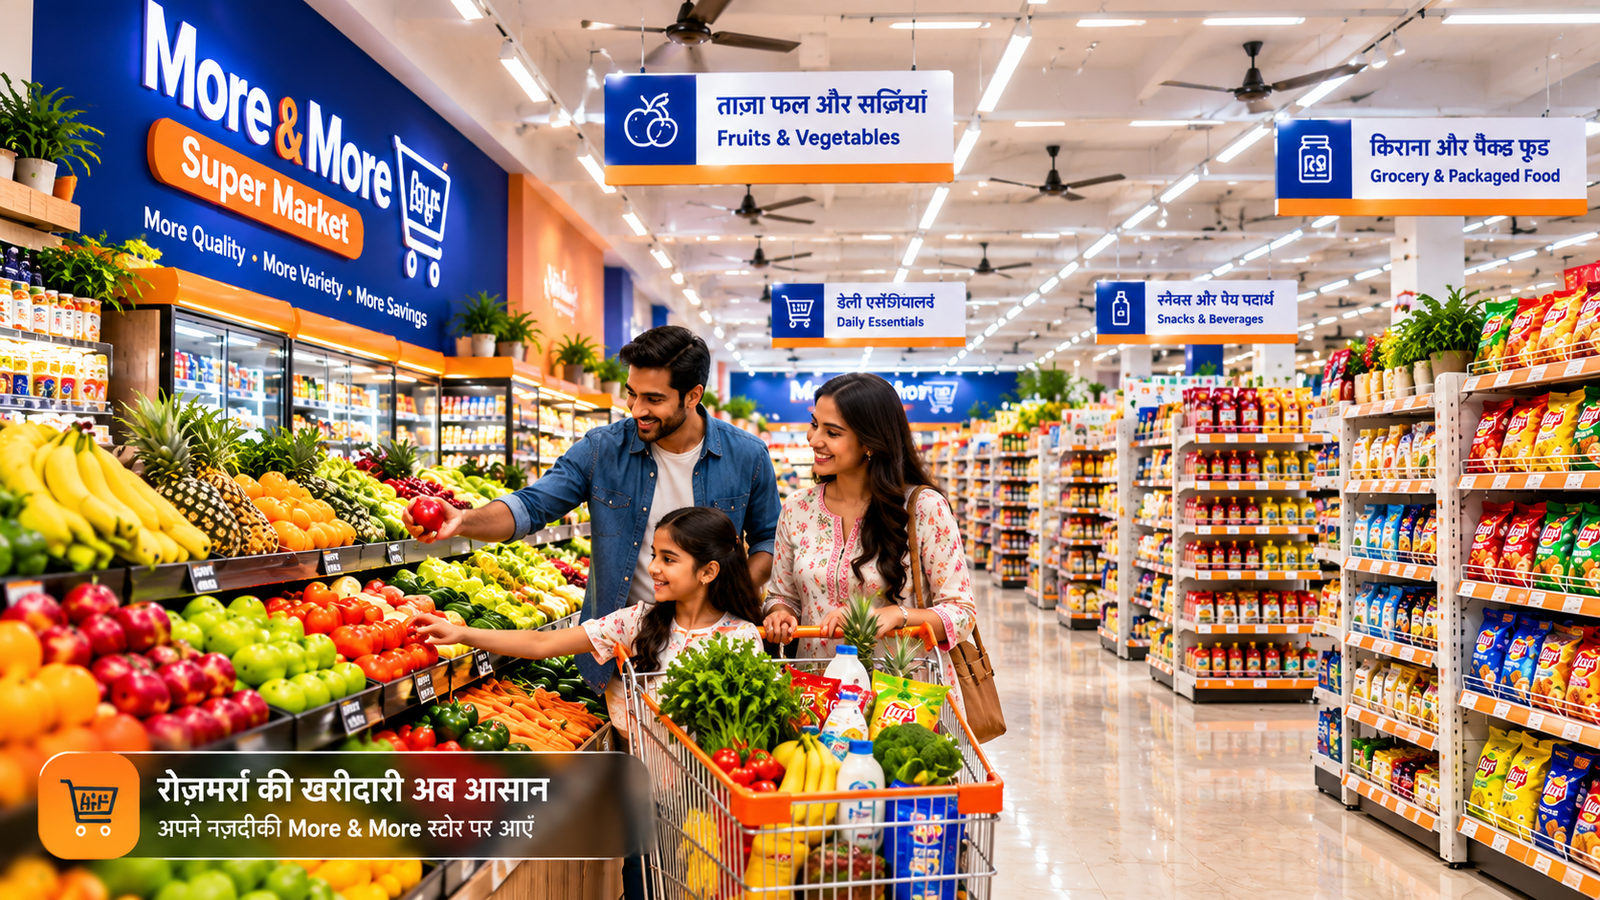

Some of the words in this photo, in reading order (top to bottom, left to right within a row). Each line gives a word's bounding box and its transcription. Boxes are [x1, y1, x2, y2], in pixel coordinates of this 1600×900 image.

[142, 0, 272, 146] More
[275, 97, 303, 165] &
[306, 99, 392, 209] More
[770, 96, 811, 115] फल
[816, 88, 852, 114] और
[717, 128, 771, 147] Fruits
[776, 129, 791, 147] &
[795, 128, 901, 151] Vegetables
[1369, 133, 1432, 157] किराना
[1436, 133, 1469, 157] और
[1518, 139, 1551, 164] फूड
[181, 135, 266, 207] Super
[273, 178, 349, 245] Market
[1370, 168, 1430, 187] Grocery
[1433, 168, 1445, 183] &
[1449, 168, 1520, 187] Packaged
[1524, 168, 1561, 183] Food
[144, 206, 188, 242] More
[192, 225, 245, 267] Quality
[263, 250, 297, 282] More
[300, 264, 343, 301] Variety
[356, 286, 385, 312] More
[387, 297, 427, 328] Savings
[836, 316, 866, 330] Daily
[868, 316, 925, 328] Essentials
[1157, 313, 1195, 325] Snacks
[1197, 313, 1207, 325] &
[1209, 313, 1264, 327] Beverages
